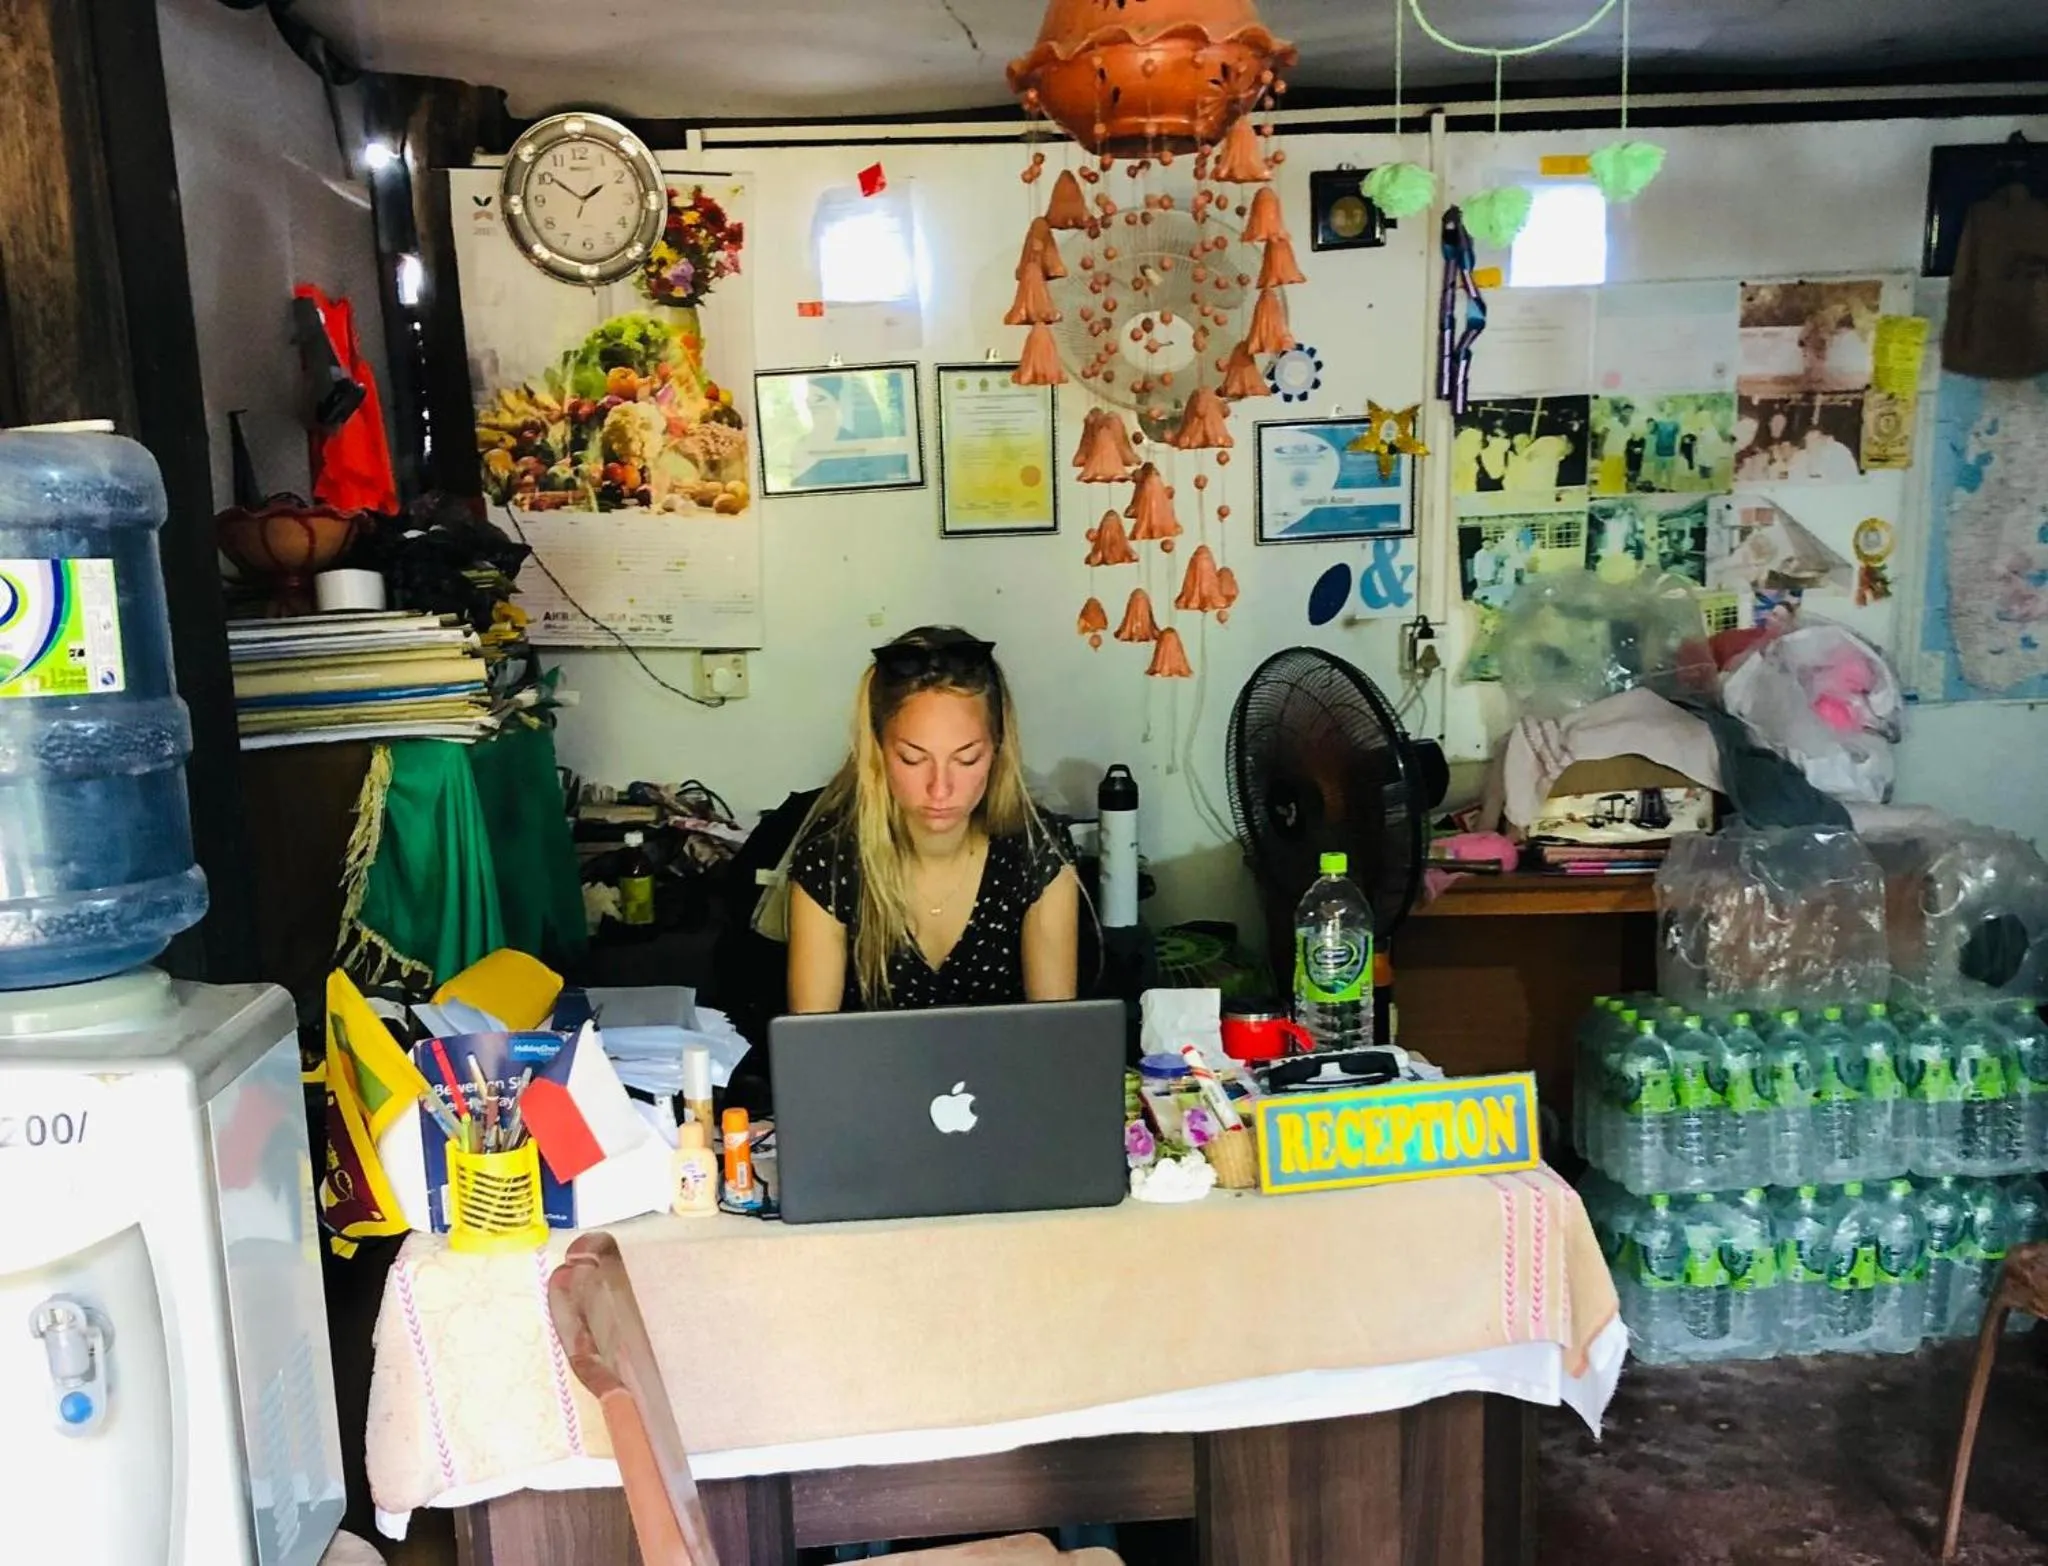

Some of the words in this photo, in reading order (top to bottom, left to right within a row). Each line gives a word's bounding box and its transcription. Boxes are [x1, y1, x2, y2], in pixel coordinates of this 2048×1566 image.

[571, 147, 588, 160] 12
[599, 153, 606, 166] 1
[552, 154, 564, 167] 11
[538, 171, 554, 185] 10
[614, 170, 625, 184] 2
[535, 194, 546, 207] 9
[623, 193, 634, 205] 3
[544, 217, 556, 230] 8
[617, 216, 628, 228] 4
[561, 232, 571, 246] 7
[604, 231, 615, 244] 5
[582, 238, 594, 251] 6
[433, 1081, 504, 1097] Bewern
[1276, 1095, 1517, 1173] RECEPTION
